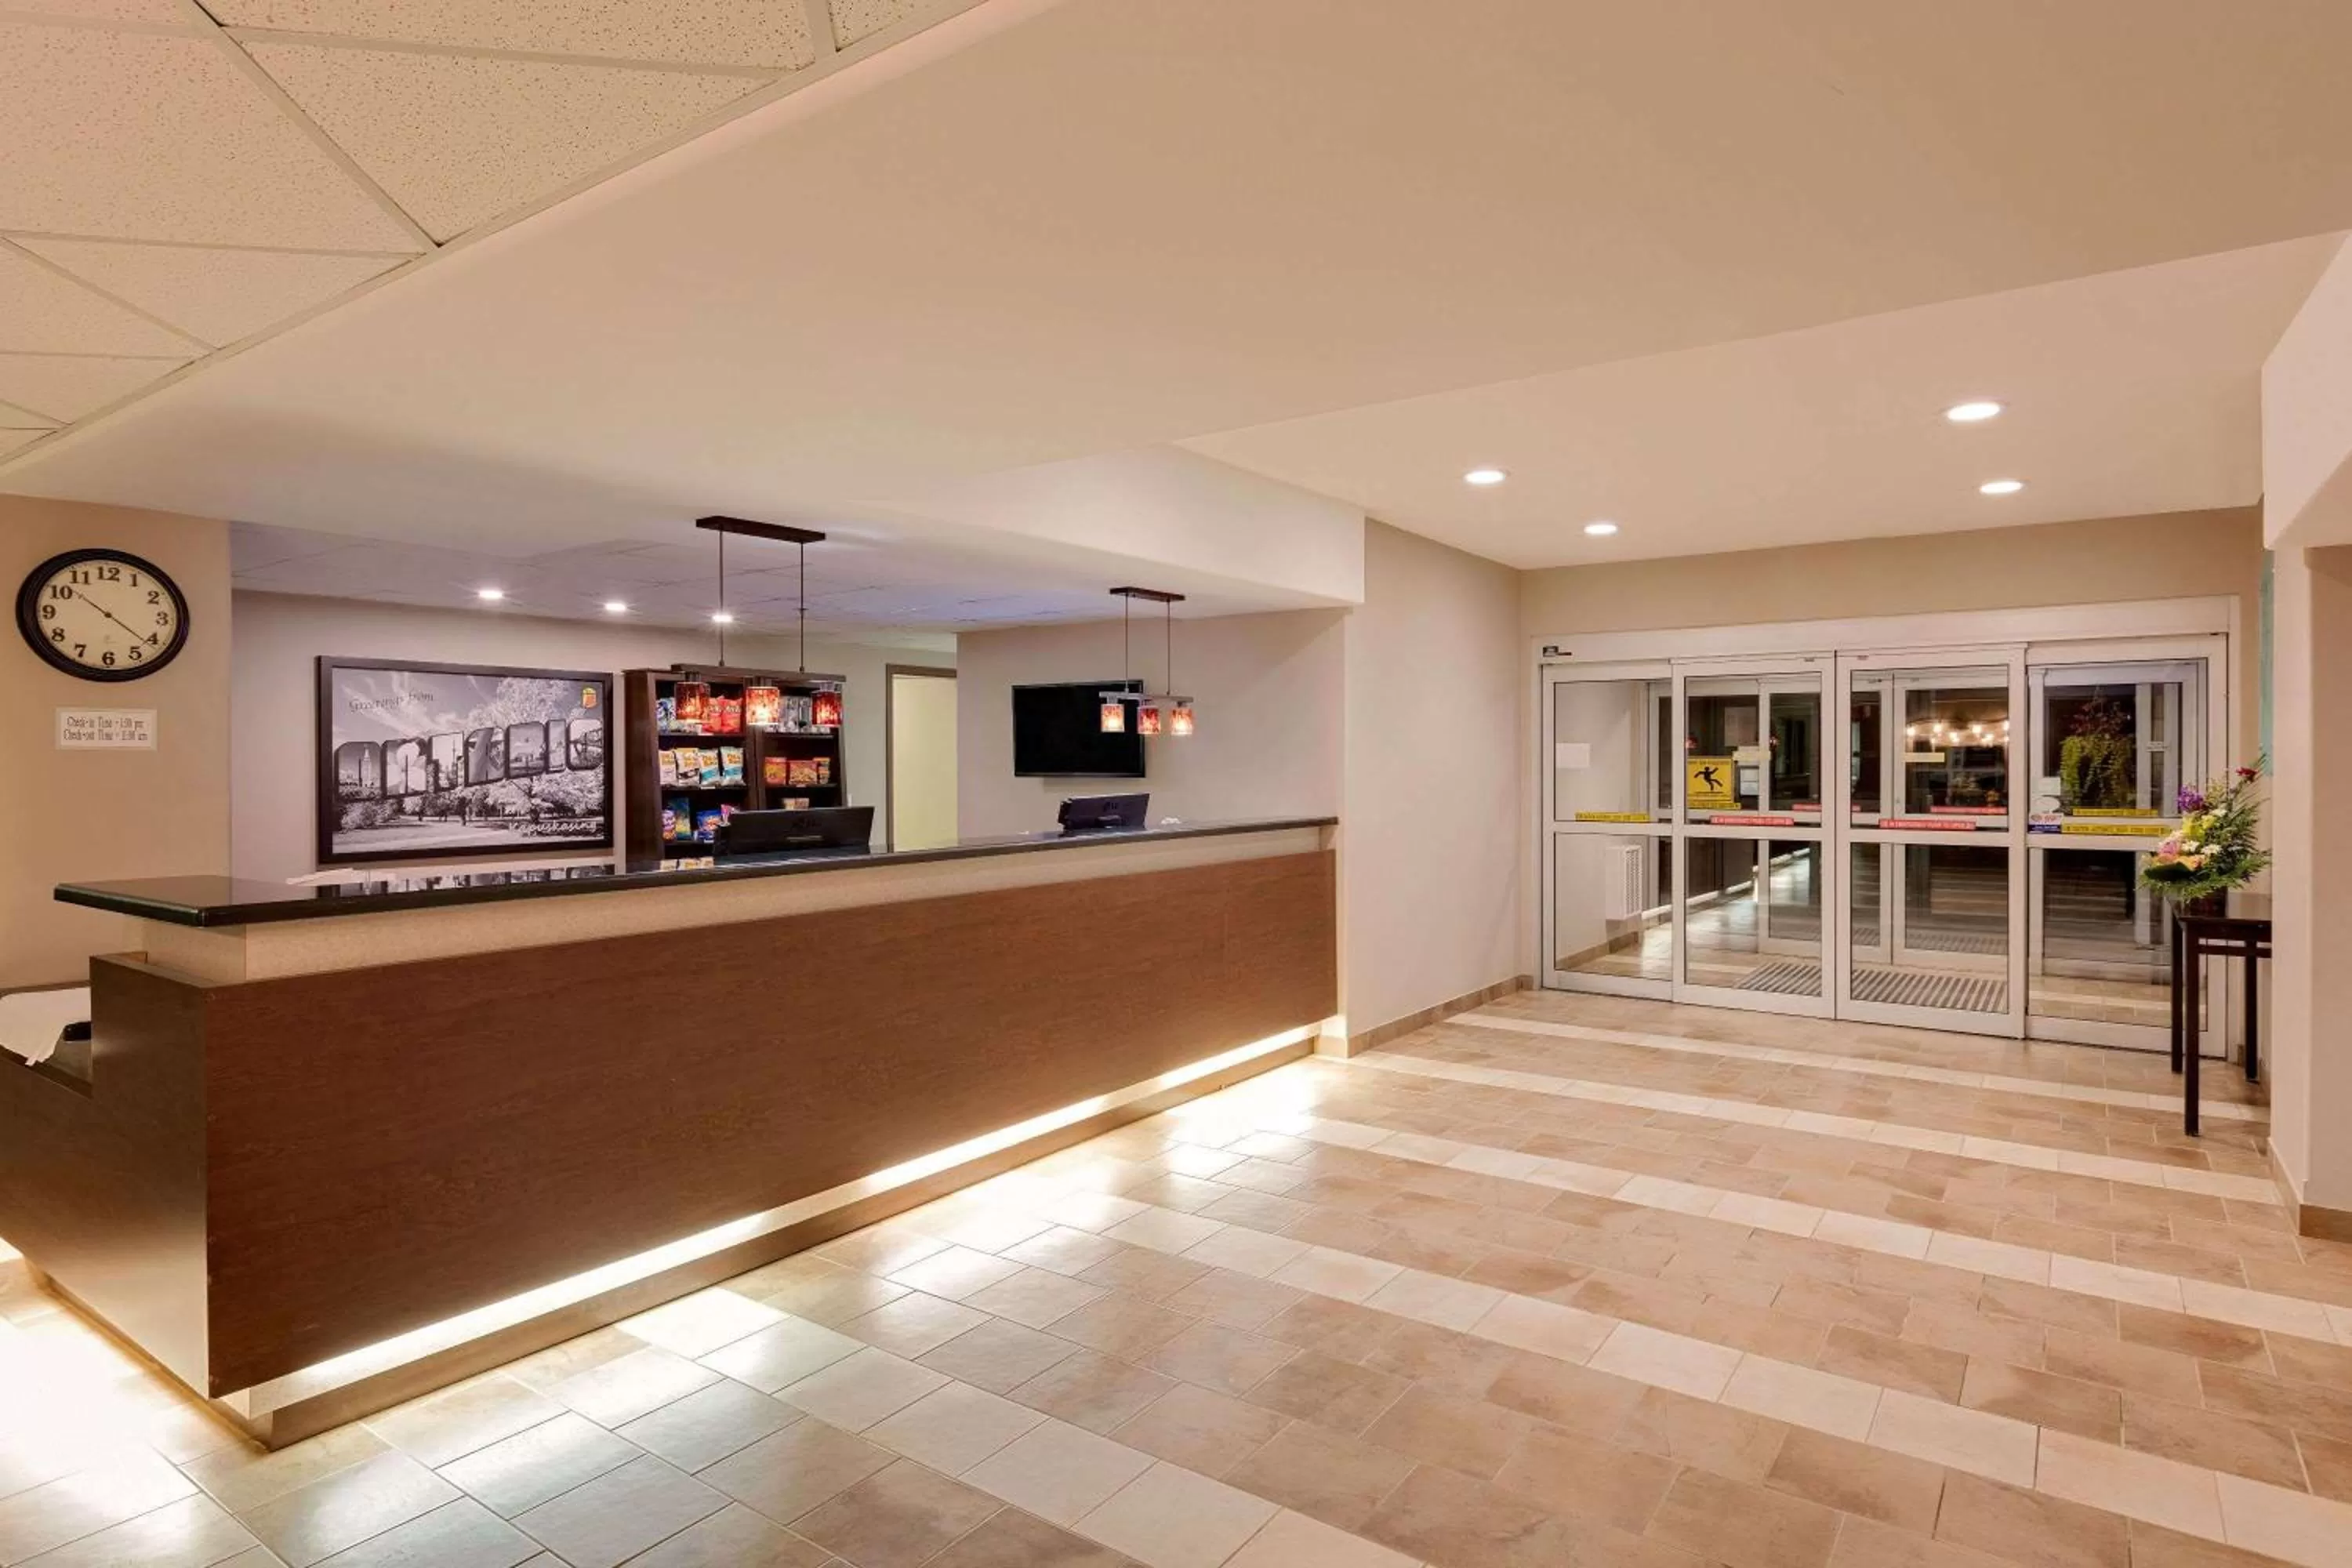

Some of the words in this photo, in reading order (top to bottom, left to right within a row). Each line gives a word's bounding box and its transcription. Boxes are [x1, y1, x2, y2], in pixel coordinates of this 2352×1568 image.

[69, 570, 91, 585] 11
[97, 566, 121, 582] 12
[129, 573, 138, 587] 1
[50, 585, 73, 600] 10
[147, 590, 160, 604] 2
[42, 604, 56, 619] 9
[156, 612, 169, 626] 3
[52, 627, 65, 642] 8
[147, 632, 158, 645] 4
[74, 644, 86, 658] 7
[129, 646, 142, 661] 5
[102, 652, 115, 666] 6
